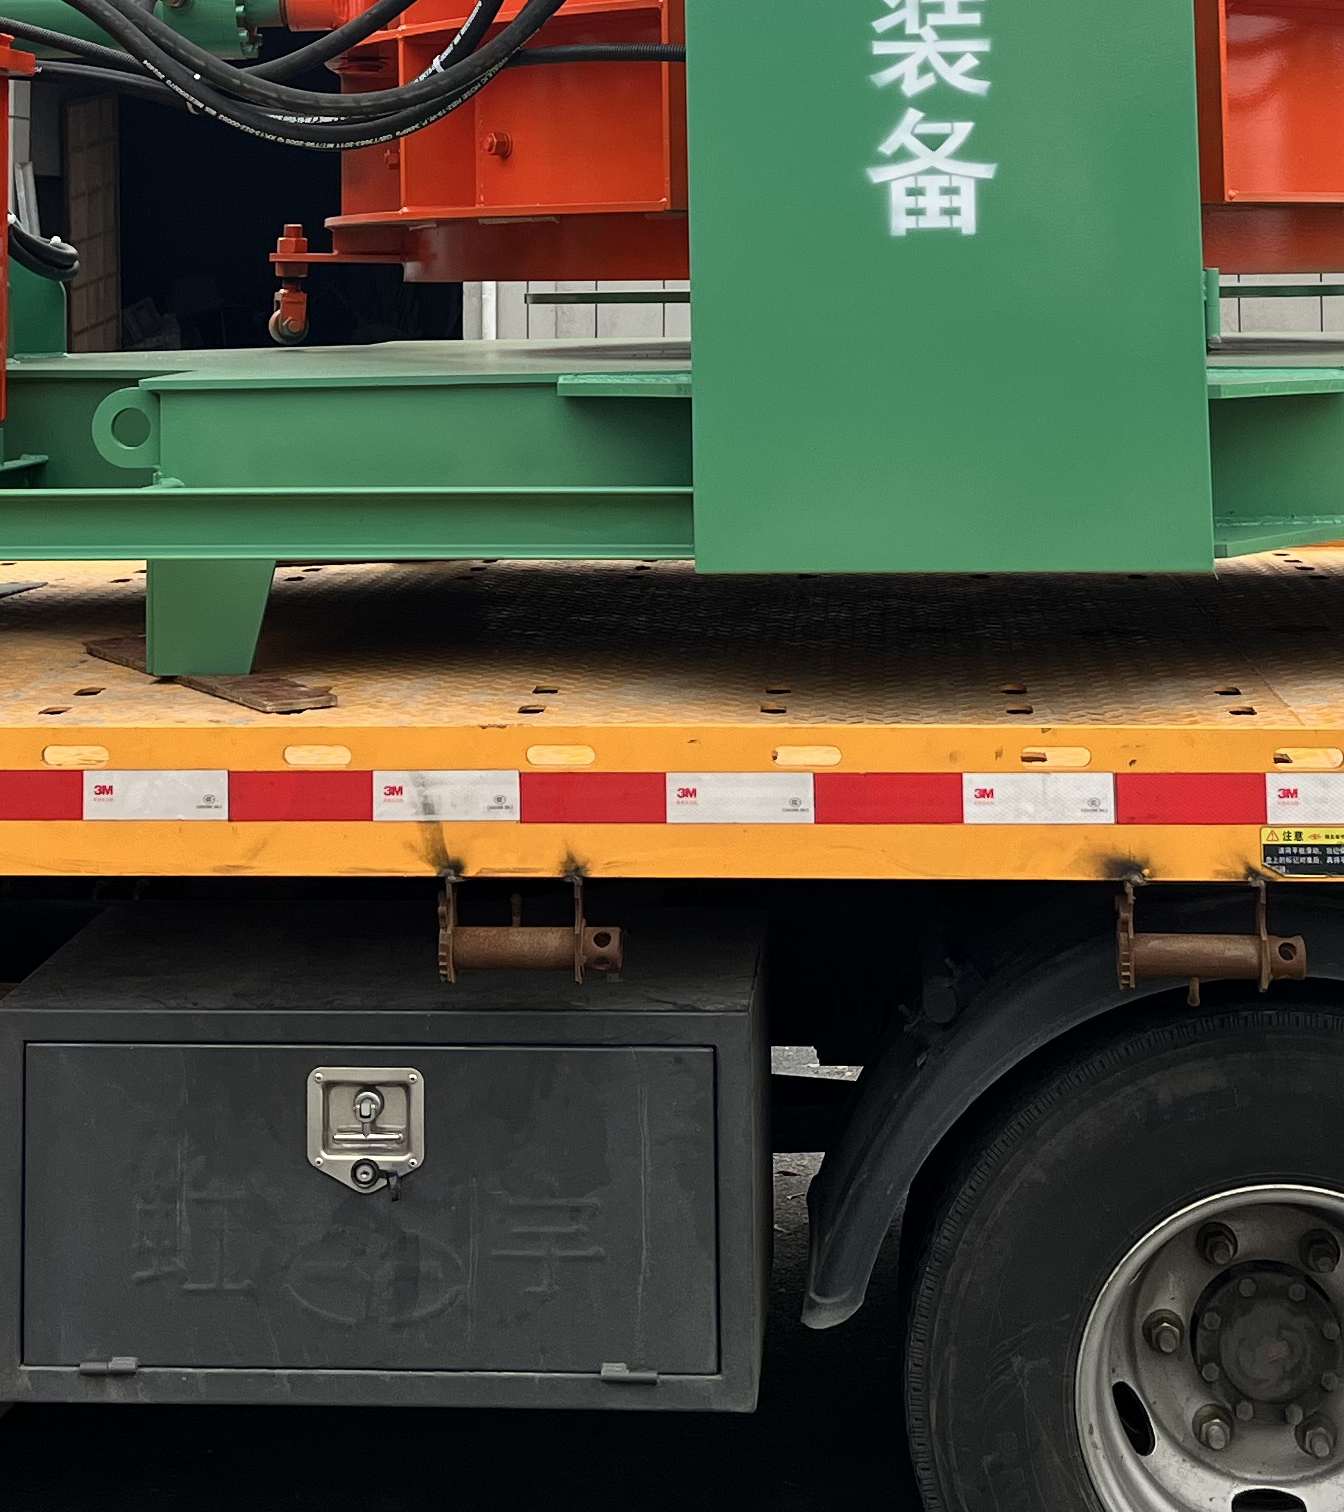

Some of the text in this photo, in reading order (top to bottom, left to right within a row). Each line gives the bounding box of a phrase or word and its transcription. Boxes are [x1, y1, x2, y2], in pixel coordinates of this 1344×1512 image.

[93, 785, 114, 796] 3M
[383, 785, 404, 797] 3M
[676, 787, 698, 799] 3M
[973, 788, 995, 800] 3M
[1277, 788, 1299, 800] 3M
[1282, 830, 1304, 842] 注意
